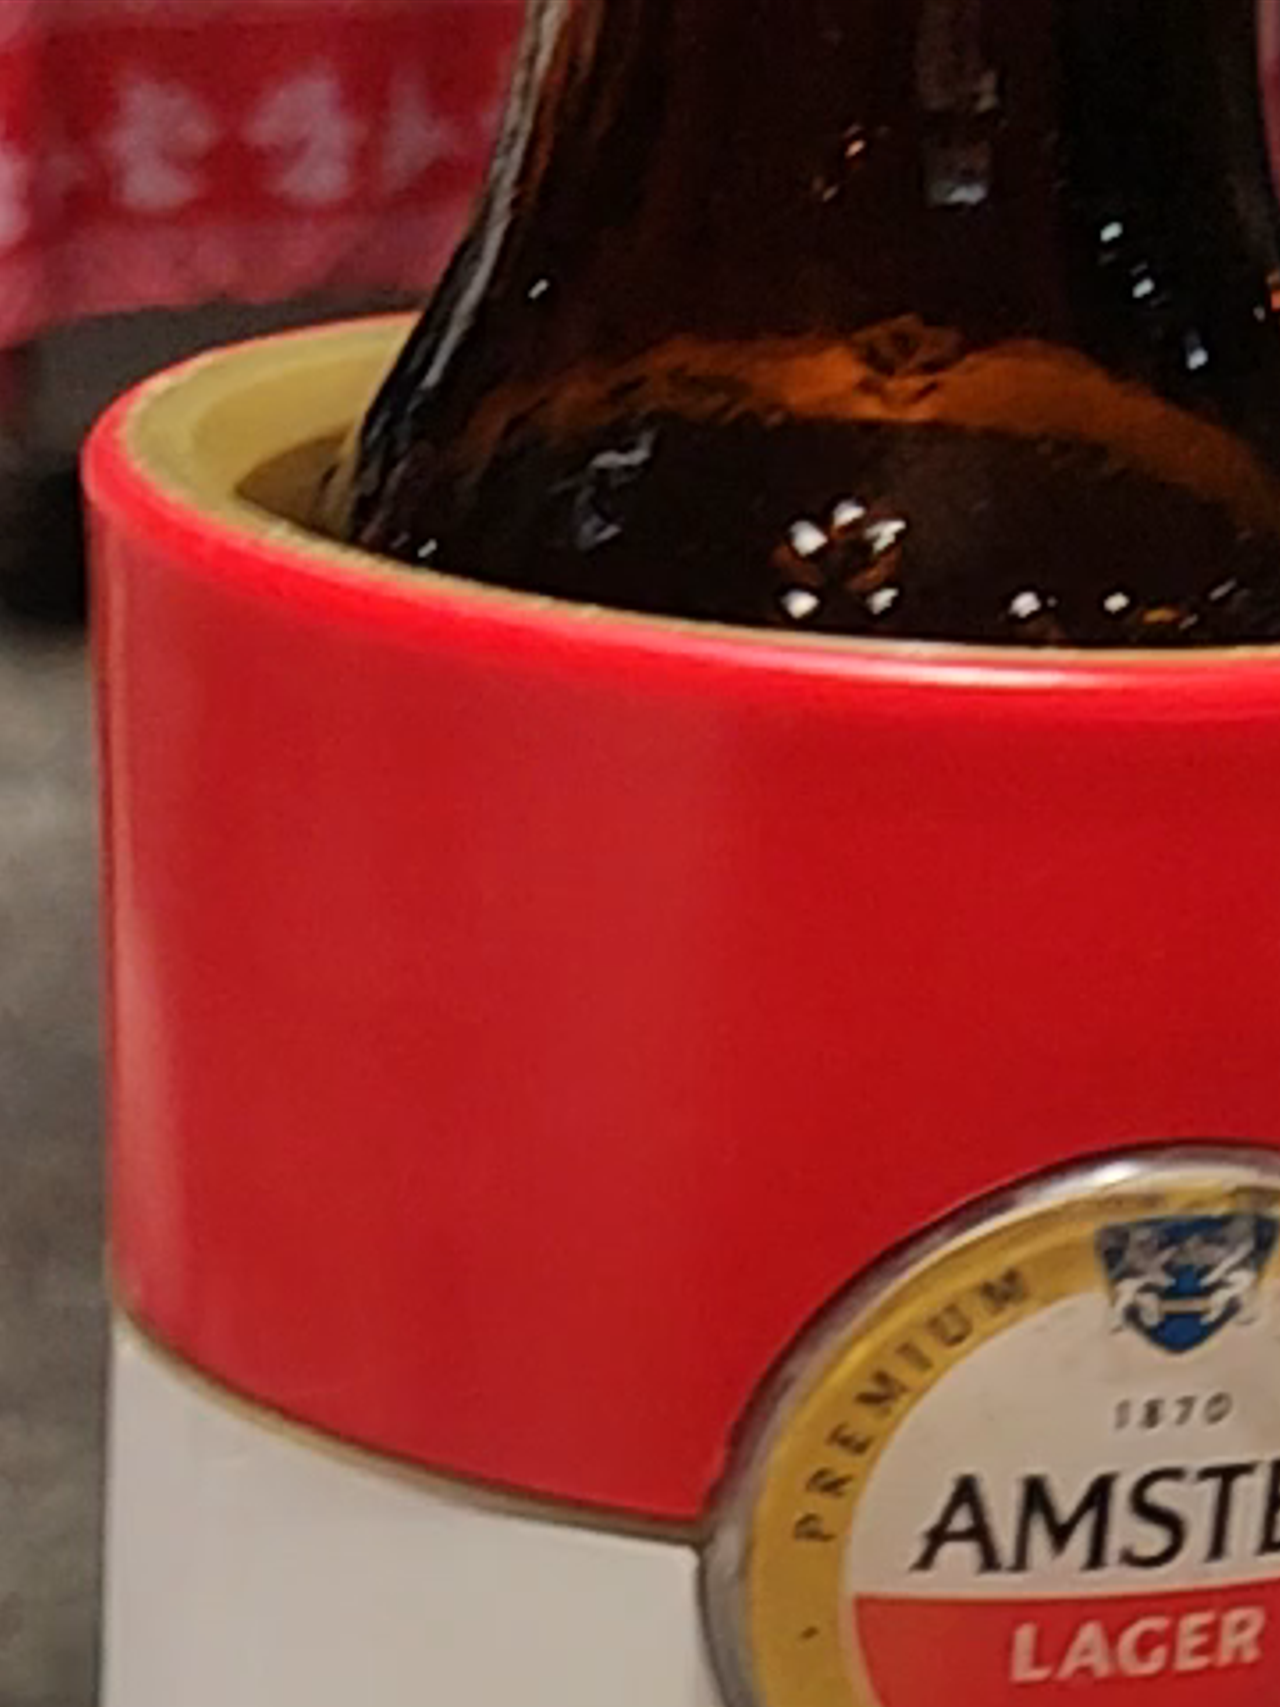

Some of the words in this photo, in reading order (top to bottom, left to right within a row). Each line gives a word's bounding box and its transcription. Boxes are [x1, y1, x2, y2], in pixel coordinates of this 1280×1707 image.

[792, 1267, 1028, 1544] PREMIUM
[1114, 1391, 1234, 1431] 1870
[1009, 1604, 1268, 1684] LAGER
